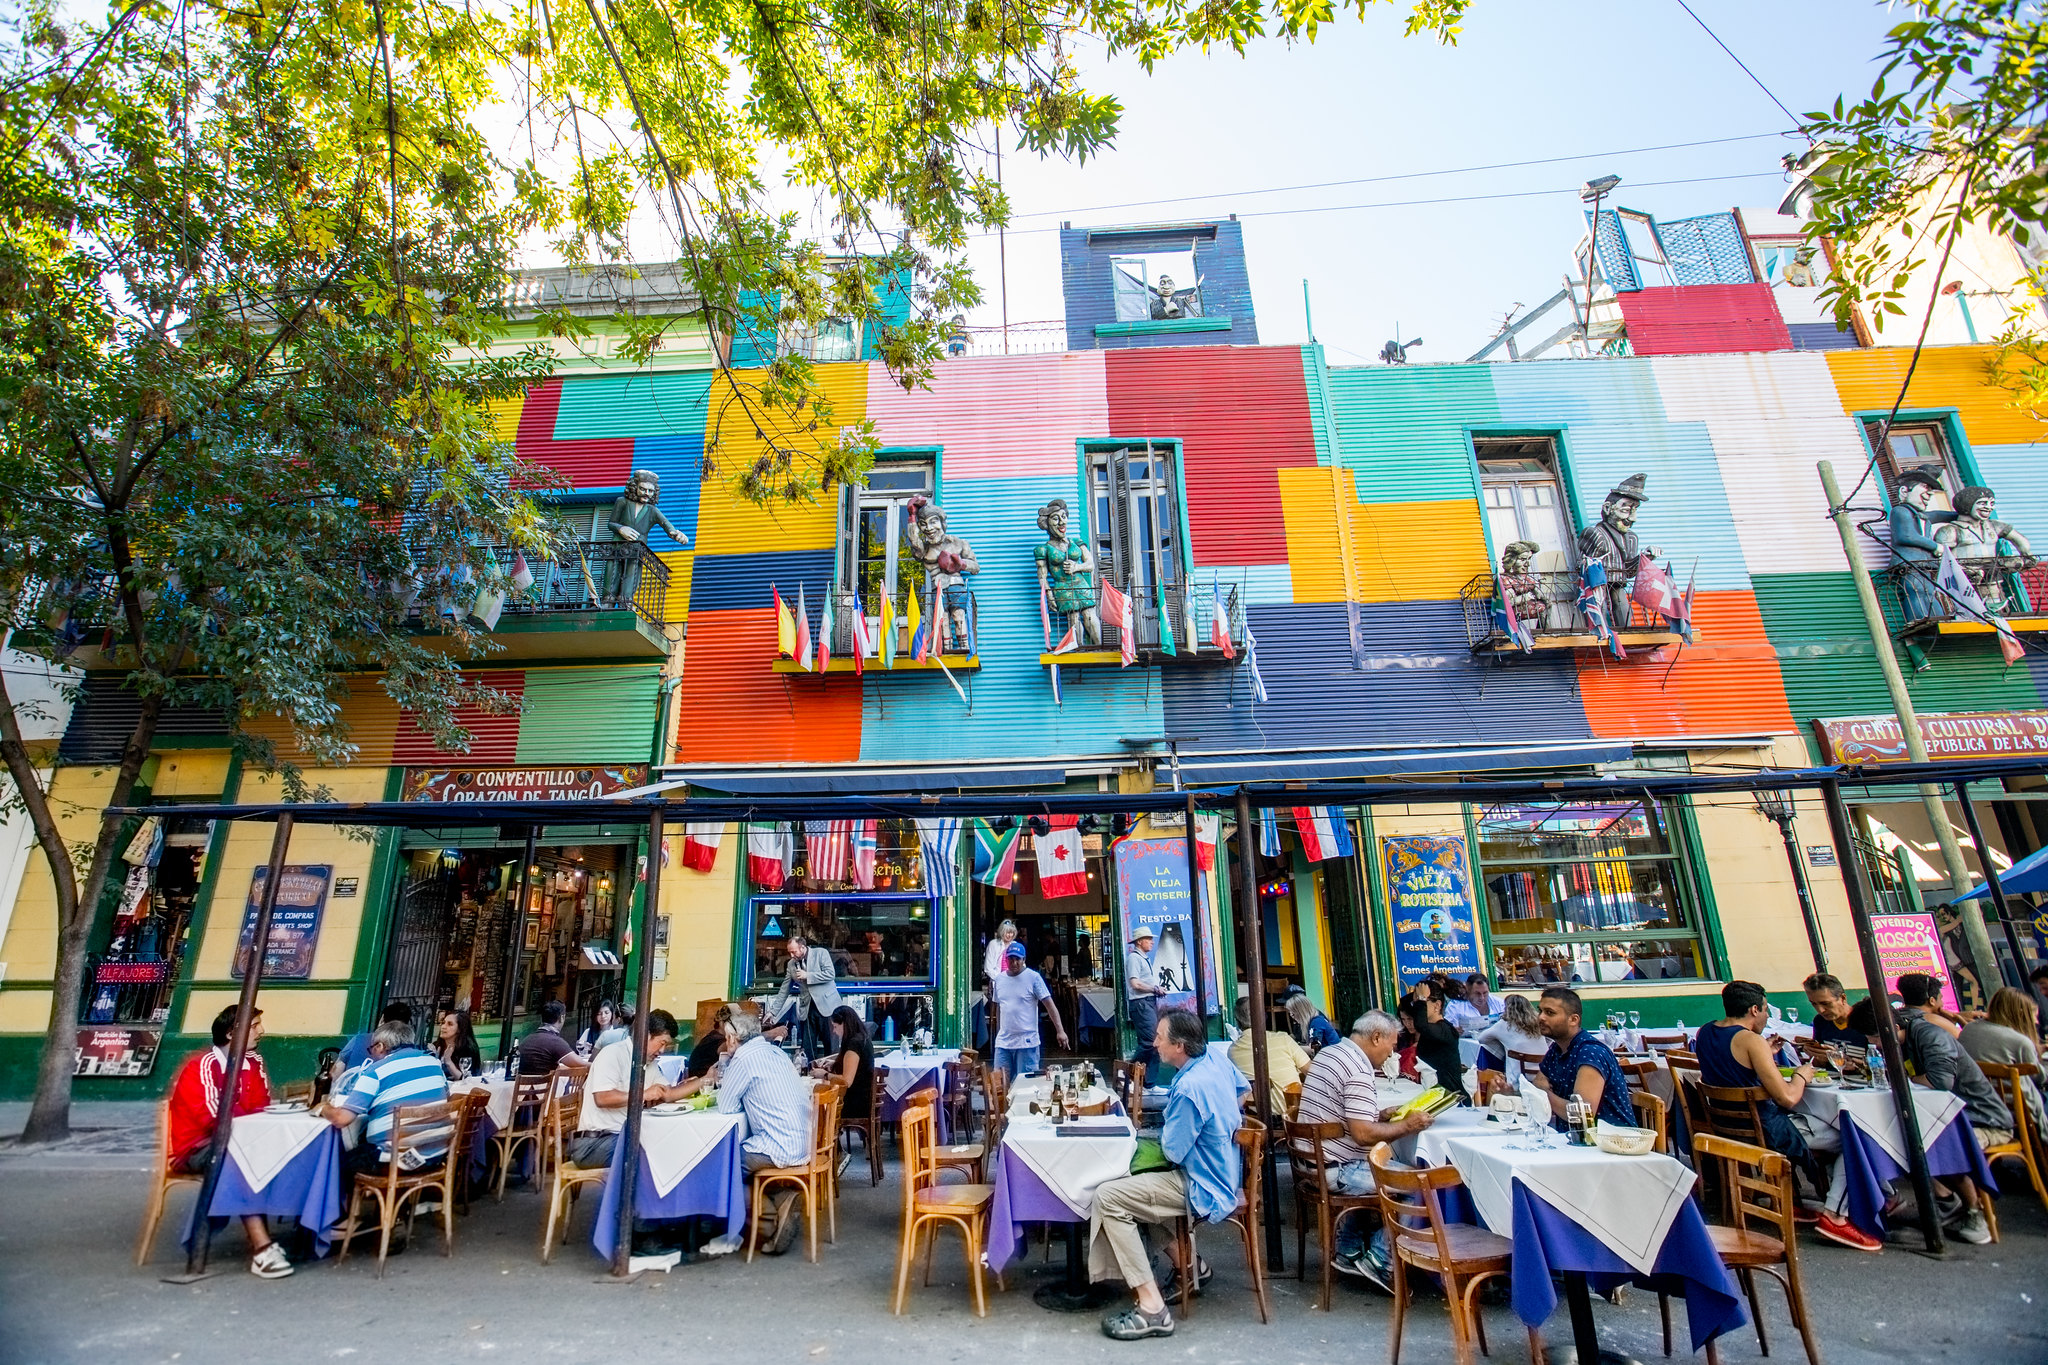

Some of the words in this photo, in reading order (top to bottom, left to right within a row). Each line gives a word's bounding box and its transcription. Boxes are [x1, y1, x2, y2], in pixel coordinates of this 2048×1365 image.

[1850, 718, 1923, 742] CENT
[1927, 718, 2023, 738] CULTURAL
[1923, 737, 1987, 753] EPUBLICA
[1992, 736, 2012, 750] DE
[2013, 735, 2035, 750] LA
[476, 770, 575, 787] CONVENTILLO
[442, 783, 519, 802] CORAZON
[522, 789, 543, 801] DE
[548, 780, 604, 801] TANGO
[1155, 866, 1171, 876] LA
[1423, 865, 1435, 875] LA
[1149, 879, 1181, 888] VIEJA
[1406, 874, 1453, 892] VIEJA
[1400, 892, 1464, 907] ROTISERIA
[1178, 913, 1192, 921] BA
[1403, 942, 1434, 951] Pastas
[1438, 942, 1470, 951] Caseras
[1420, 954, 1460, 964] Mariscos
[1879, 951, 1924, 959] OLOSINAS
[1885, 960, 1919, 968] BEBIDAS
[99, 967, 160, 978] ALFAJORES
[1401, 965, 1431, 975] Carnes
[1433, 964, 1477, 975] Argentinas
[1884, 969, 1931, 977] IGARRILLOS
[90, 1037, 130, 1048] Argentina
